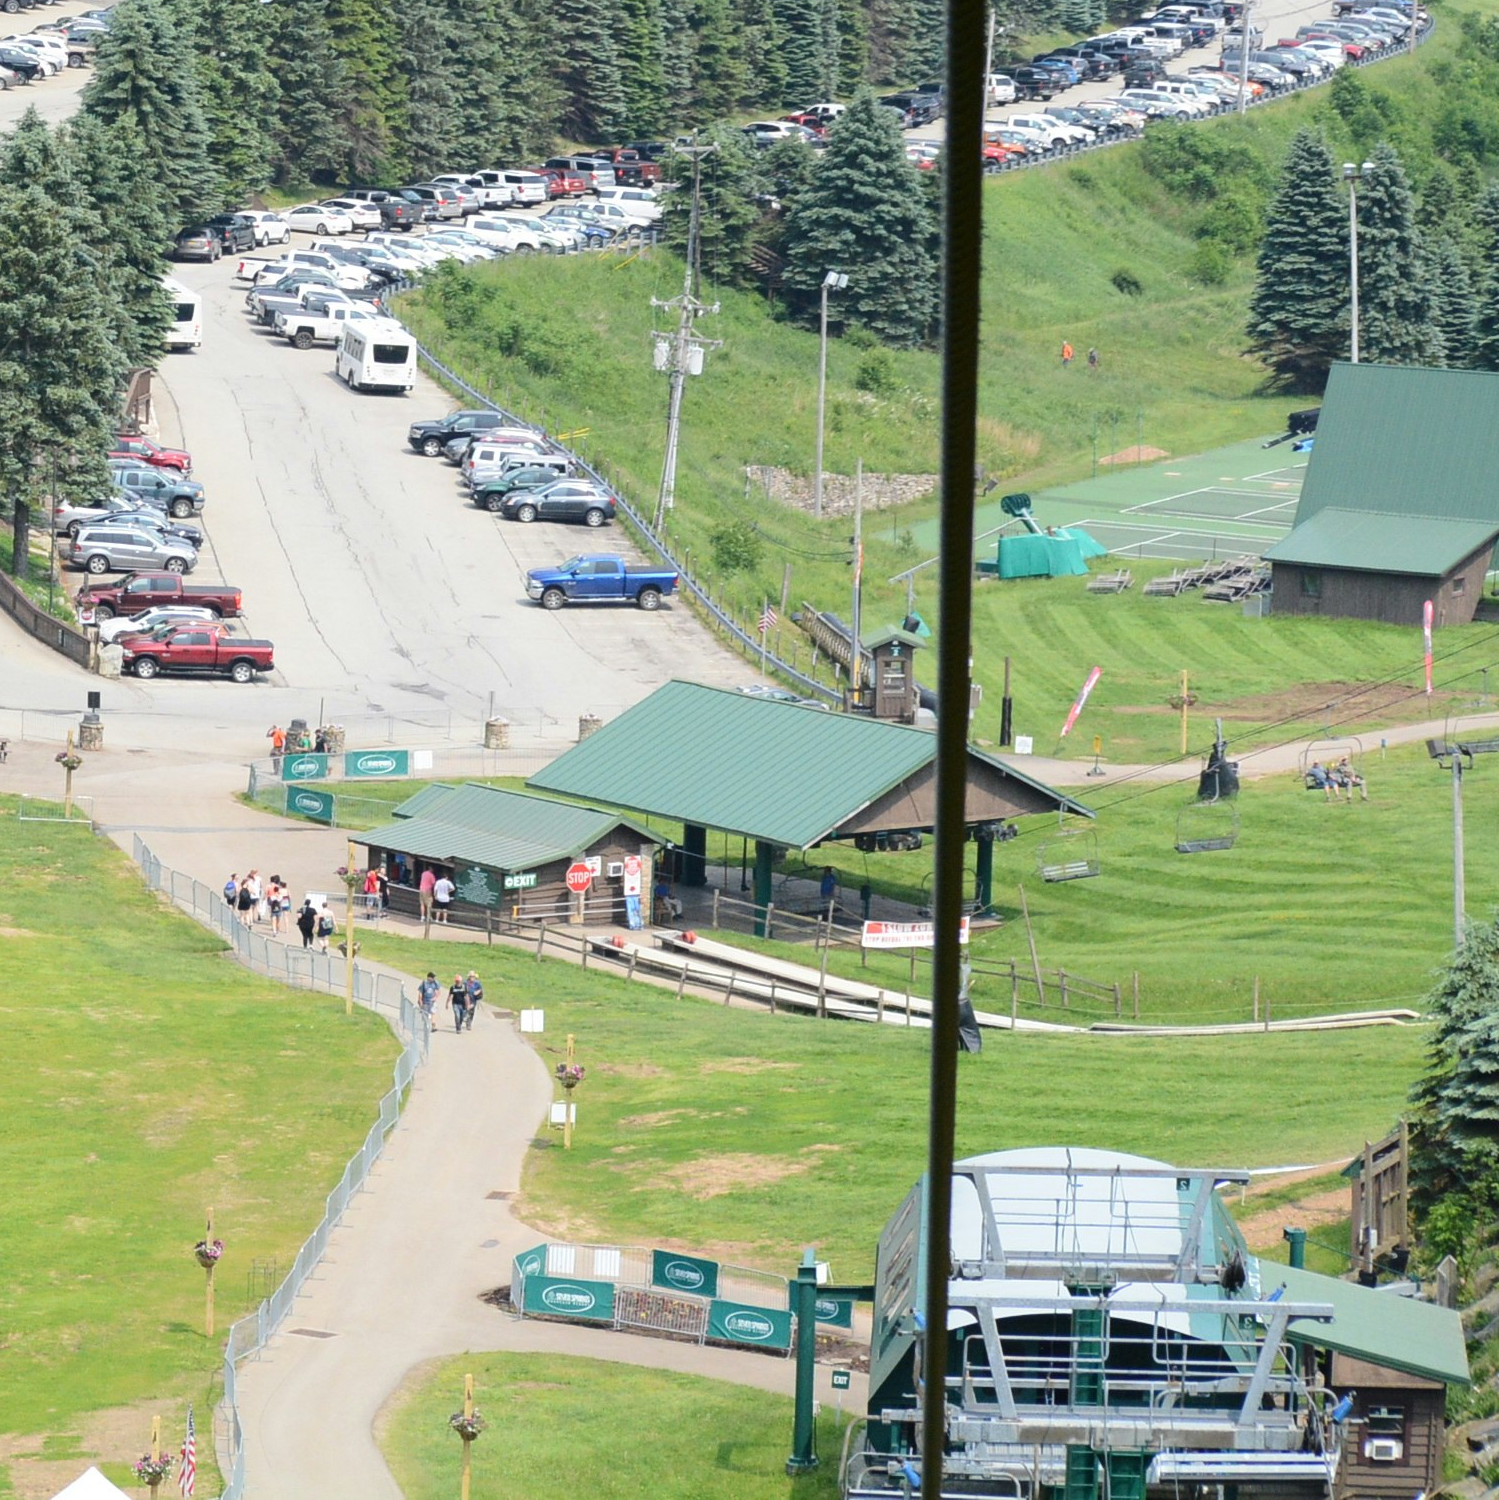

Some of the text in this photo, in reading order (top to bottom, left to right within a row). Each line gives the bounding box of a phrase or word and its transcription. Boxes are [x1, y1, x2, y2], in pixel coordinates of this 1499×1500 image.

[513, 874, 536, 887] EXIT
[568, 872, 590, 884] STOP
[833, 1375, 848, 1385] EXIT
